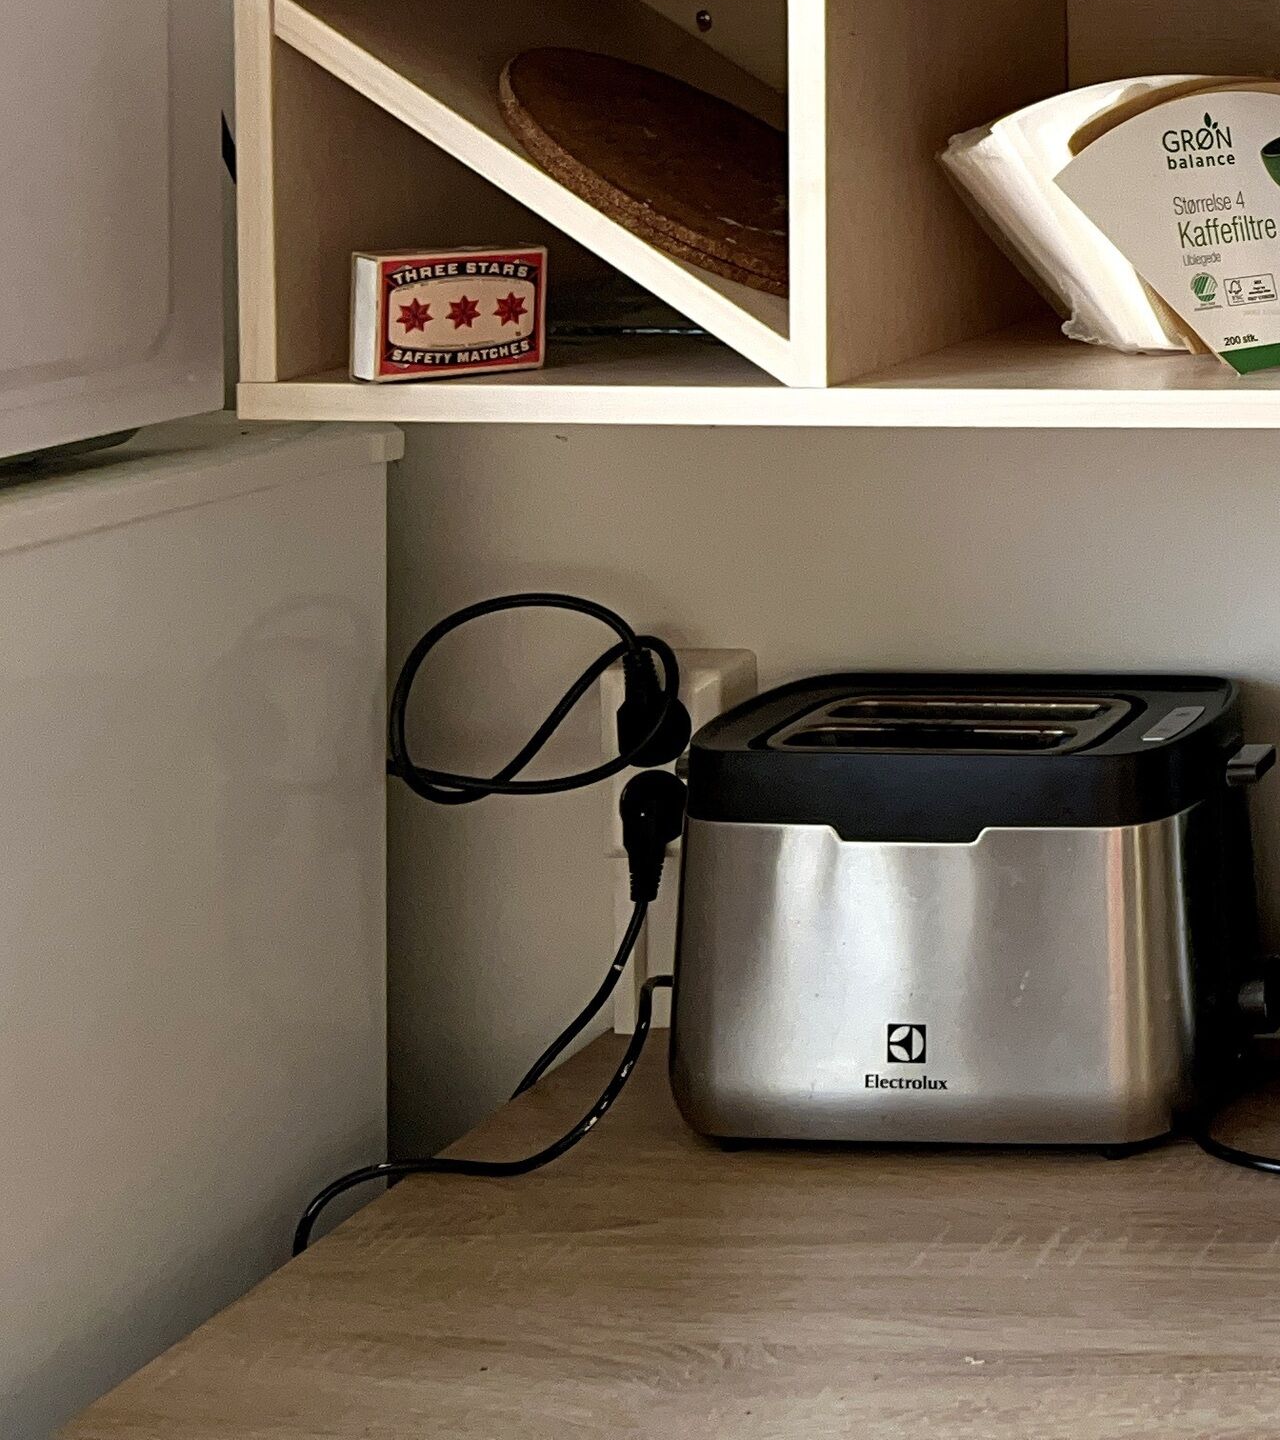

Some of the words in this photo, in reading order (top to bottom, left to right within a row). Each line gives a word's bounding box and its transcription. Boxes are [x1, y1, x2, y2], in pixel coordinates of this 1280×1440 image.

[1162, 126, 1233, 153] GRØN
[1166, 153, 1236, 170] balance
[1173, 193, 1232, 216] Størrelse
[1235, 190, 1246, 210] 4
[1177, 214, 1278, 249] Kaffefiltre
[392, 262, 459, 285] THREE
[465, 261, 529, 278] STARS
[392, 349, 457, 364] SAFETY
[457, 340, 531, 363] MATCHES
[1223, 335, 1242, 347] 200
[865, 1074, 949, 1091] Electrolux
